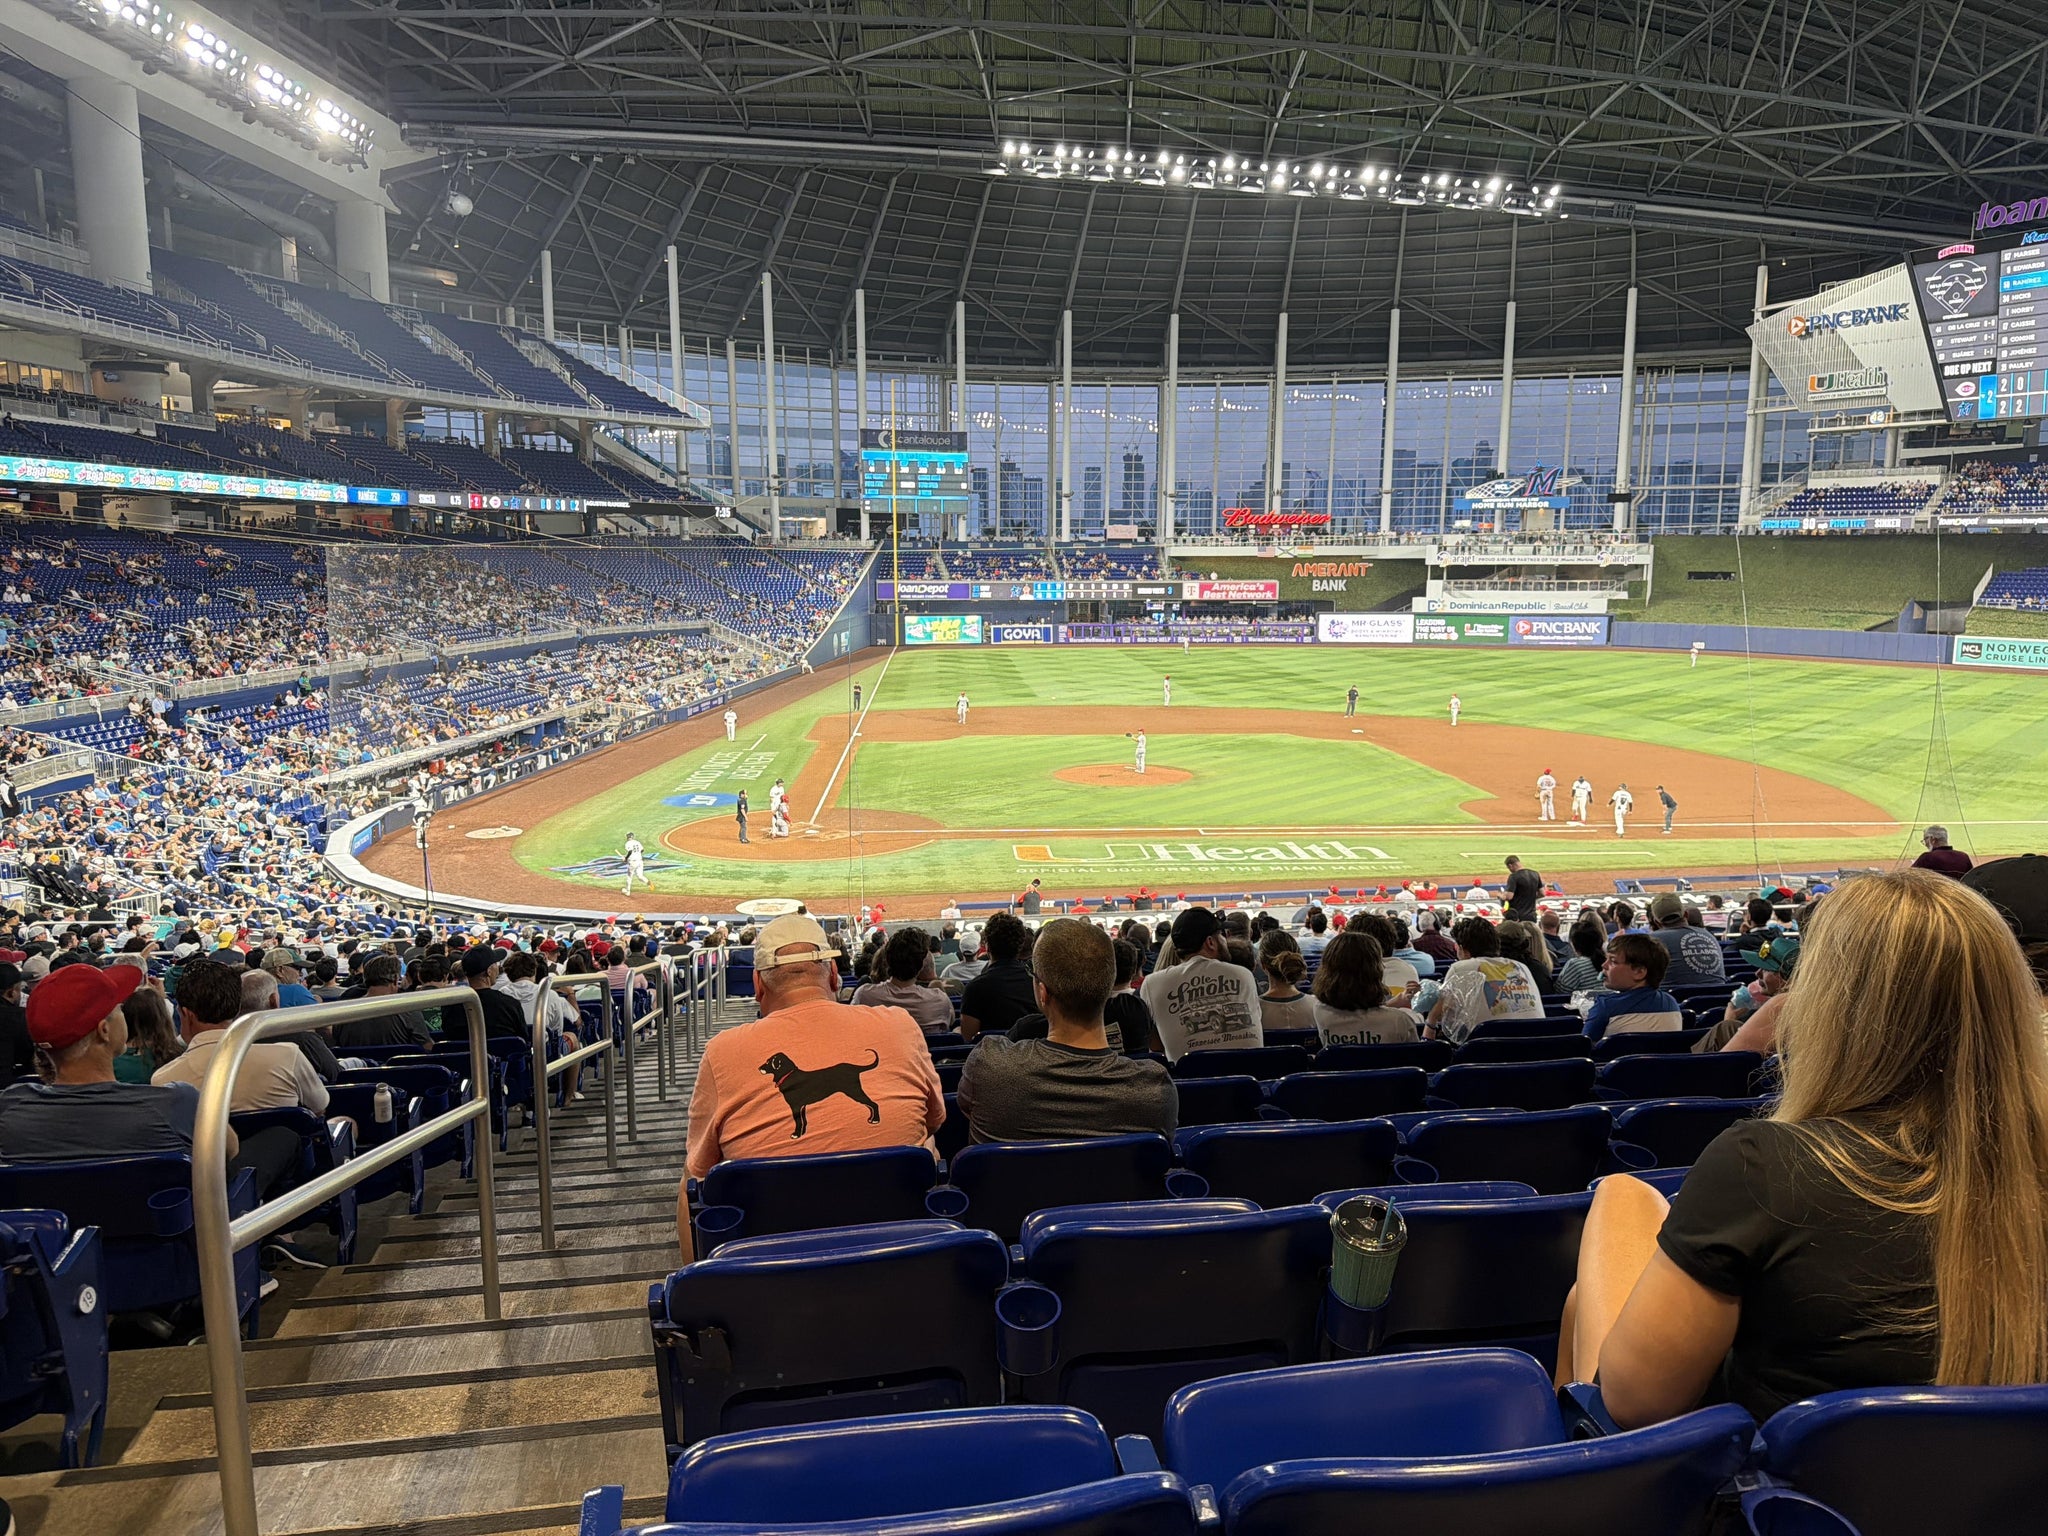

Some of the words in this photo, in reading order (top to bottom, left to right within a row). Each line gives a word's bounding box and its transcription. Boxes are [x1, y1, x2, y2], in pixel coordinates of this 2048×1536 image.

[2013, 262, 2045, 271] EDWARDS
[2011, 306, 2034, 314] NORBY
[2011, 320, 2036, 328] CAISSIE
[1944, 365, 1959, 376] DUE
[1960, 363, 1970, 375] UP
[1972, 361, 1992, 374] NEXT
[2009, 362, 2034, 370] PAULEY
[2001, 378, 2007, 392] 2
[2017, 377, 2024, 390] 0
[1987, 390, 1993, 403] 2
[2000, 401, 2006, 414] 2
[2016, 399, 2022, 413] 2
[1871, 411, 1883, 420] 42
[898, 436, 951, 446] cantaloupe
[47, 466, 70, 479] Blast
[104, 470, 124, 483] Blast
[482, 496, 487, 507] 2
[525, 499, 530, 509] 4
[1222, 508, 1332, 526] Budweiser
[1802, 518, 1816, 530] 90
[1452, 555, 1475, 567] arajet
[1612, 555, 1635, 567] arajet
[1292, 563, 1369, 577] AMERANT
[898, 583, 949, 593] loanDepot
[1167, 586, 1173, 595] 3
[1211, 582, 1265, 591] America's
[1312, 579, 1347, 591] BANK
[1203, 591, 1231, 599] Best
[1232, 590, 1273, 599] Network
[1003, 628, 1041, 640] GOYA
[1986, 653, 2024, 662] CRUISE
[2028, 655, 2048, 664] LIN
[1191, 975, 1215, 987] Ole
[1168, 975, 1240, 1014] Smoky
[1186, 1038, 1220, 1048] Tennessee
[1222, 1032, 1258, 1042] Moonshine
